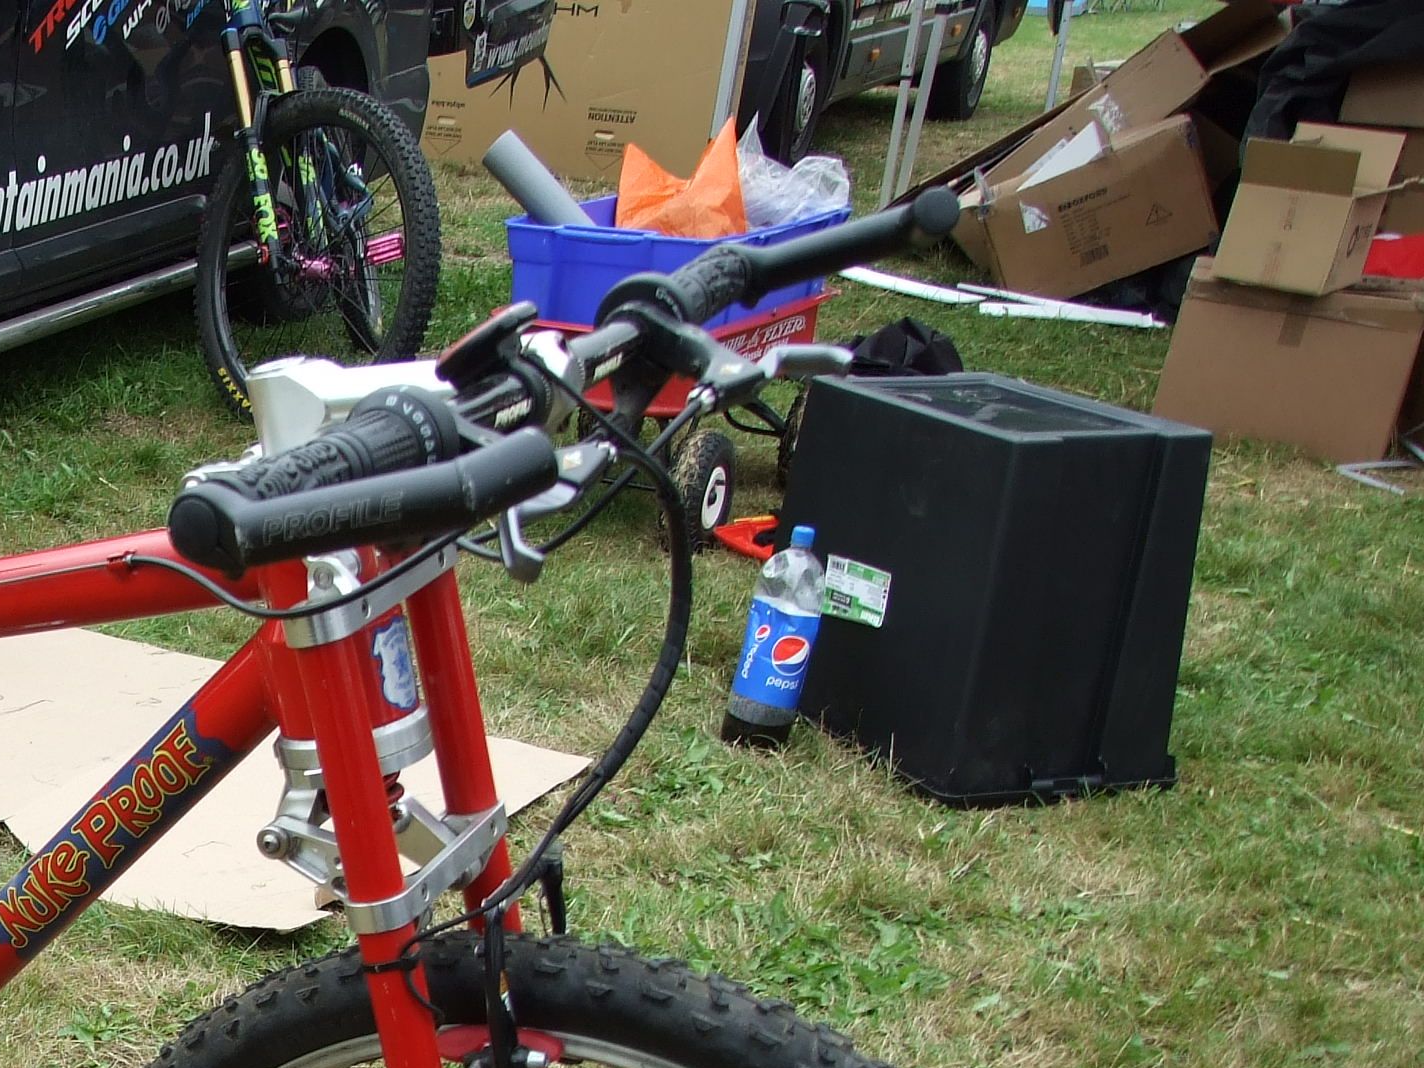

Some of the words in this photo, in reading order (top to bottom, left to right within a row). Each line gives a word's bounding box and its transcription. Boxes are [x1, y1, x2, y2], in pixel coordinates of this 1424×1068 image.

[587, 112, 636, 124] ATTENTION
[254, 193, 279, 243] FOX
[760, 316, 805, 344] FLYER
[262, 491, 404, 545] PROFILE
[765, 675, 799, 690] pepsi
[71, 719, 211, 869] PROOF
